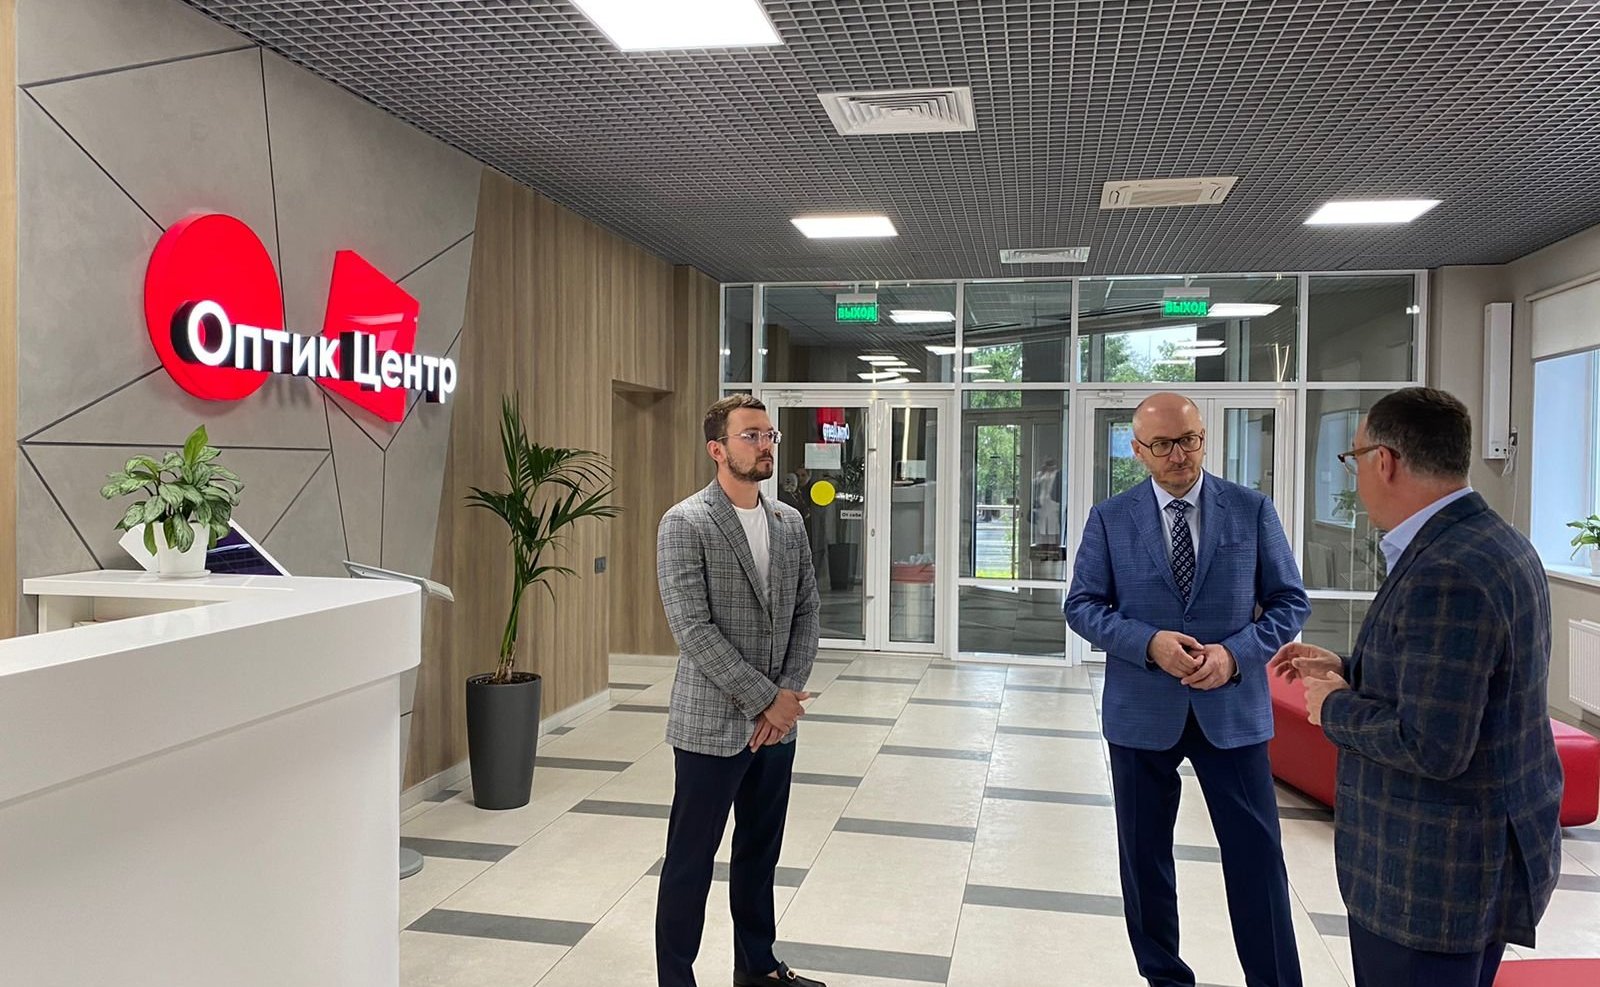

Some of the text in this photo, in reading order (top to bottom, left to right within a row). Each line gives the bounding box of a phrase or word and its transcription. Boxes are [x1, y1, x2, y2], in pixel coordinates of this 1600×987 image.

[838, 306, 875, 319] ВЫХОД
[1164, 301, 1207, 315] ВЫХОД
[187, 300, 457, 403] Оптик Центр
